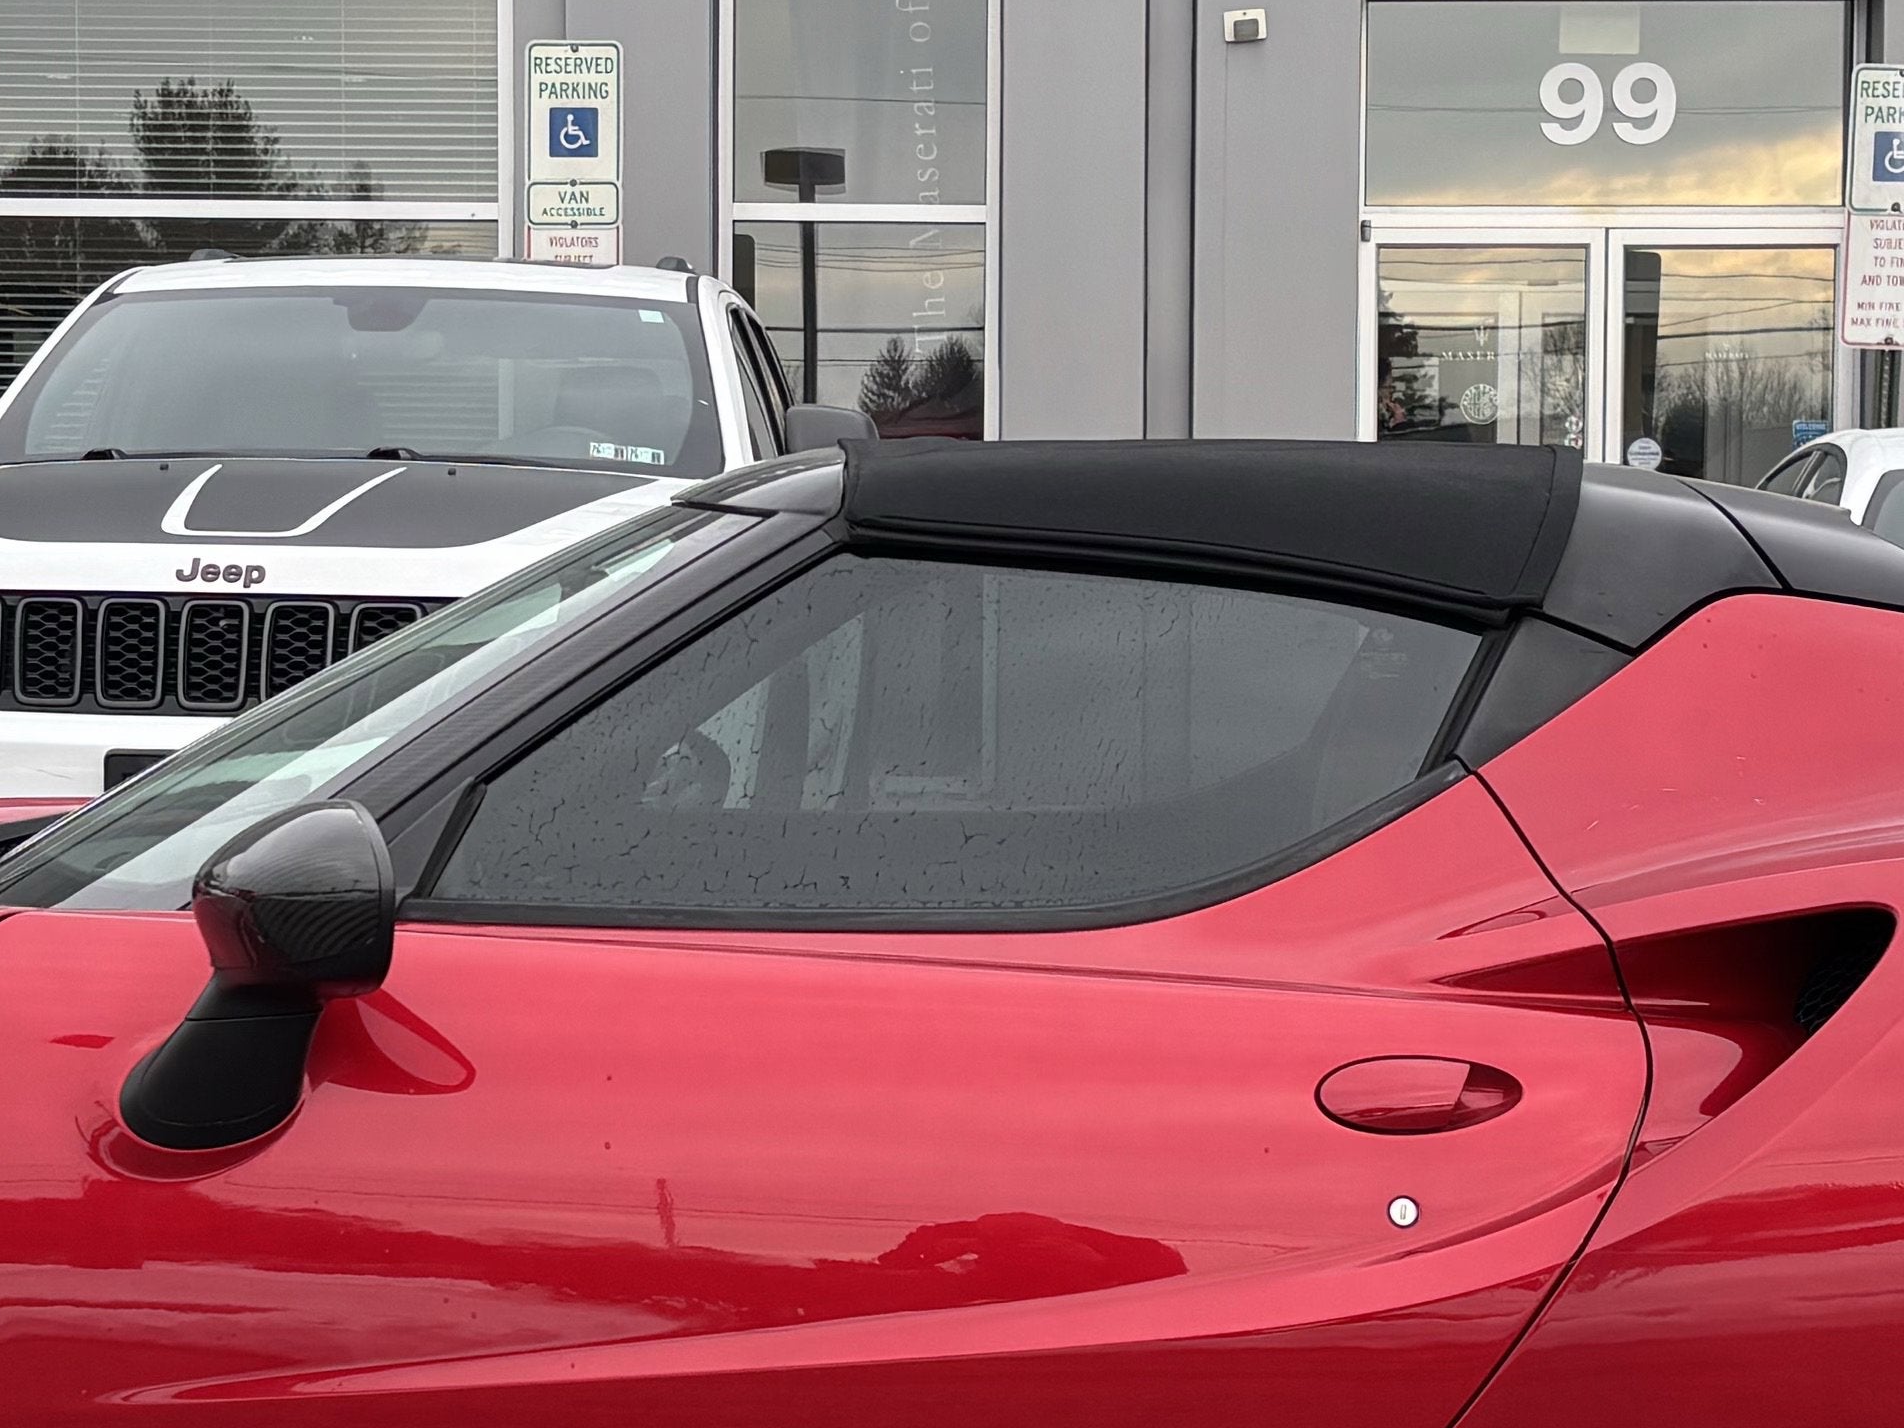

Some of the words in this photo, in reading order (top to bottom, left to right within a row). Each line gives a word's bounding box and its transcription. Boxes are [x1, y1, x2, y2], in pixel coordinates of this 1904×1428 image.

[533, 56, 615, 75] RESERVED
[538, 81, 610, 100] PARKING
[1538, 61, 1677, 146] 99
[558, 190, 590, 205] VAN
[541, 206, 606, 218] ACCESSIBLE
[1873, 256, 1887, 269] TO
[1860, 275, 1883, 287] AND
[175, 557, 266, 589] Jeep
